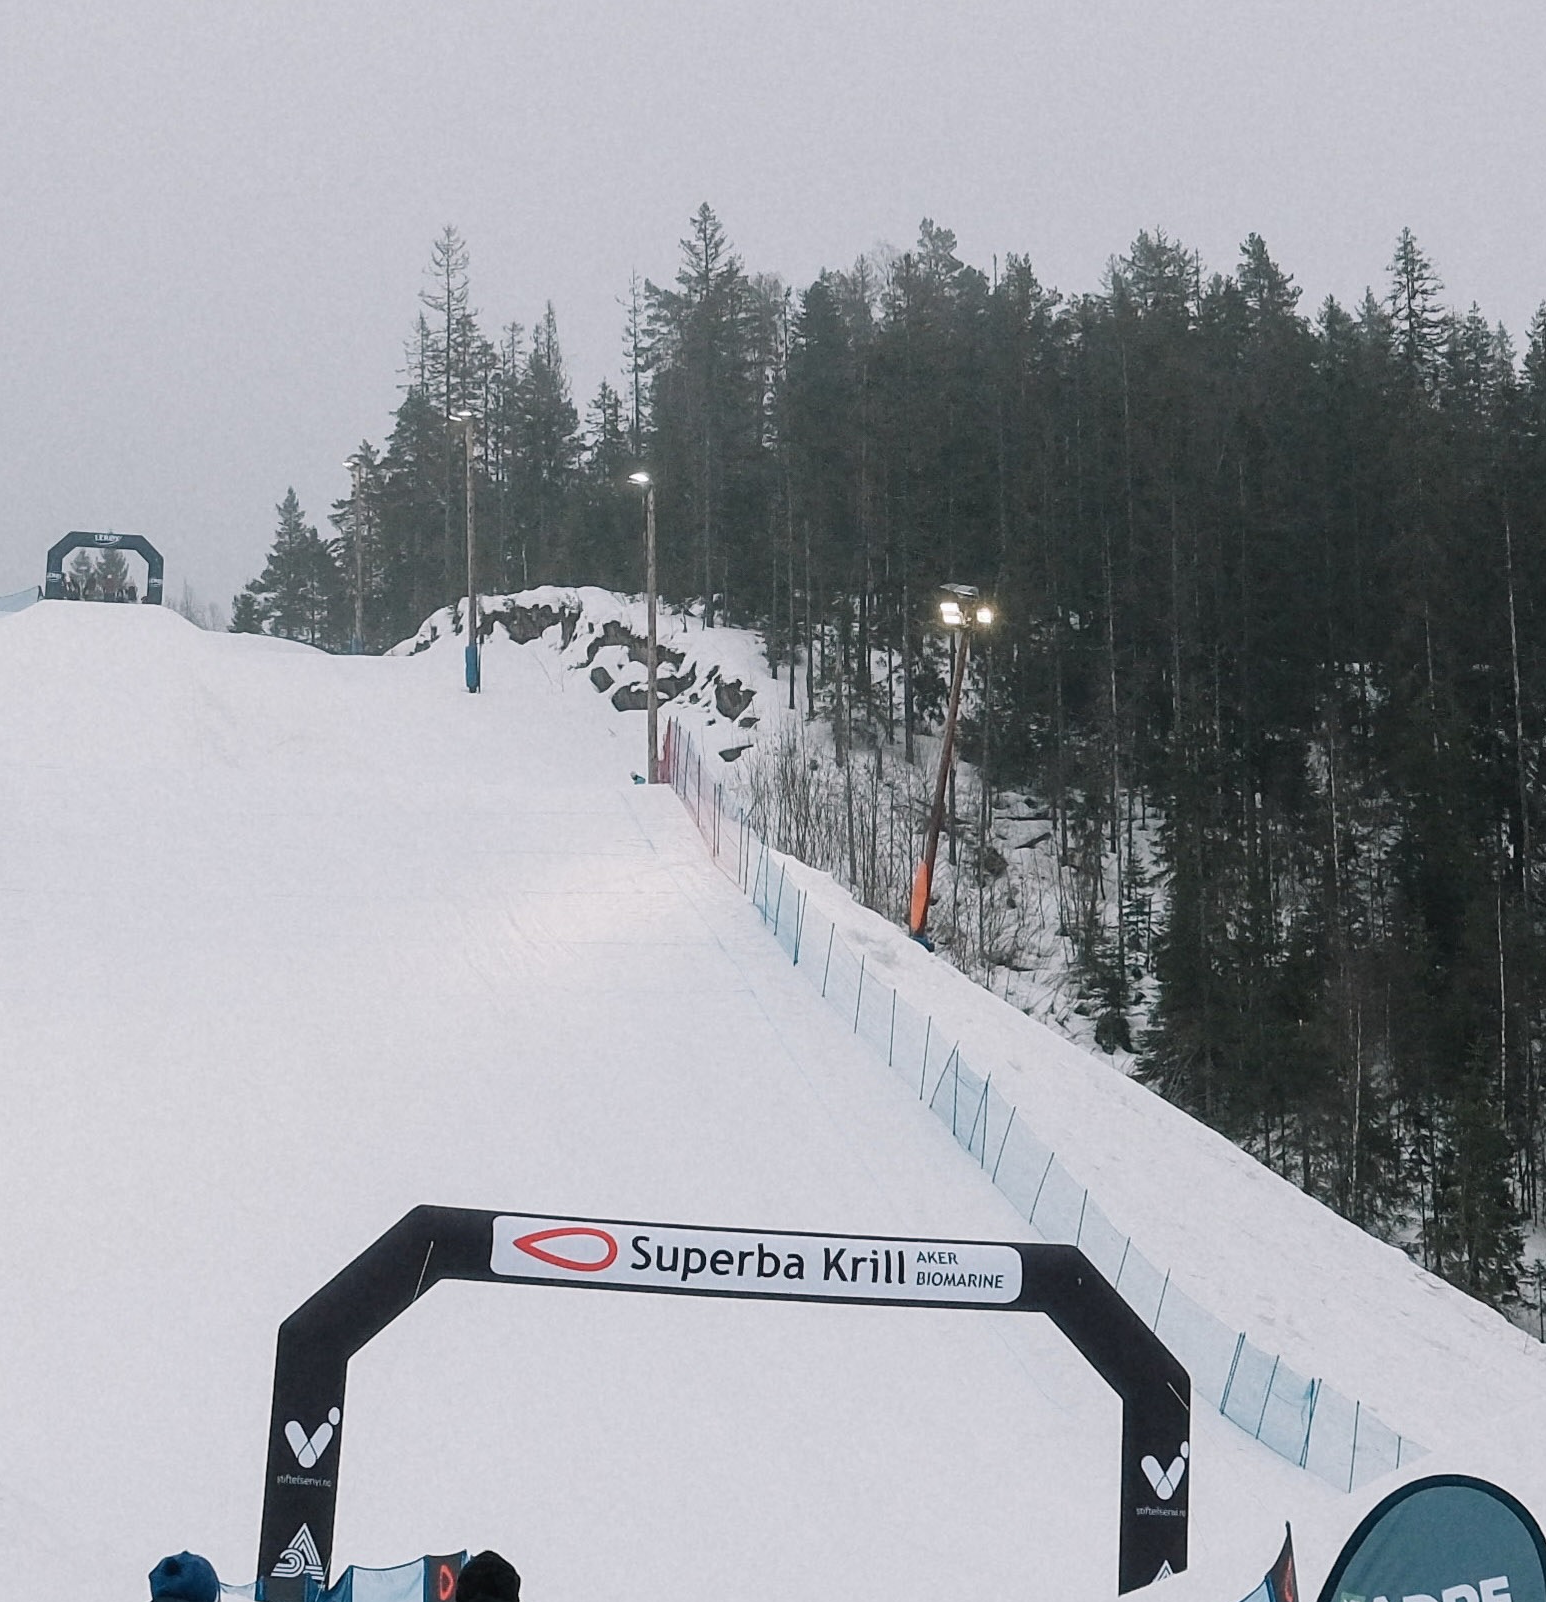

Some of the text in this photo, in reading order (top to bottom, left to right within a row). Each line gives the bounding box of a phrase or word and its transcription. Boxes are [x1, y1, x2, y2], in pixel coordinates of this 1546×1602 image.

[631, 1235, 906, 1285] Superba Krill
[916, 1251, 959, 1265] AKER
[916, 1272, 1004, 1290] BIOMARINE
